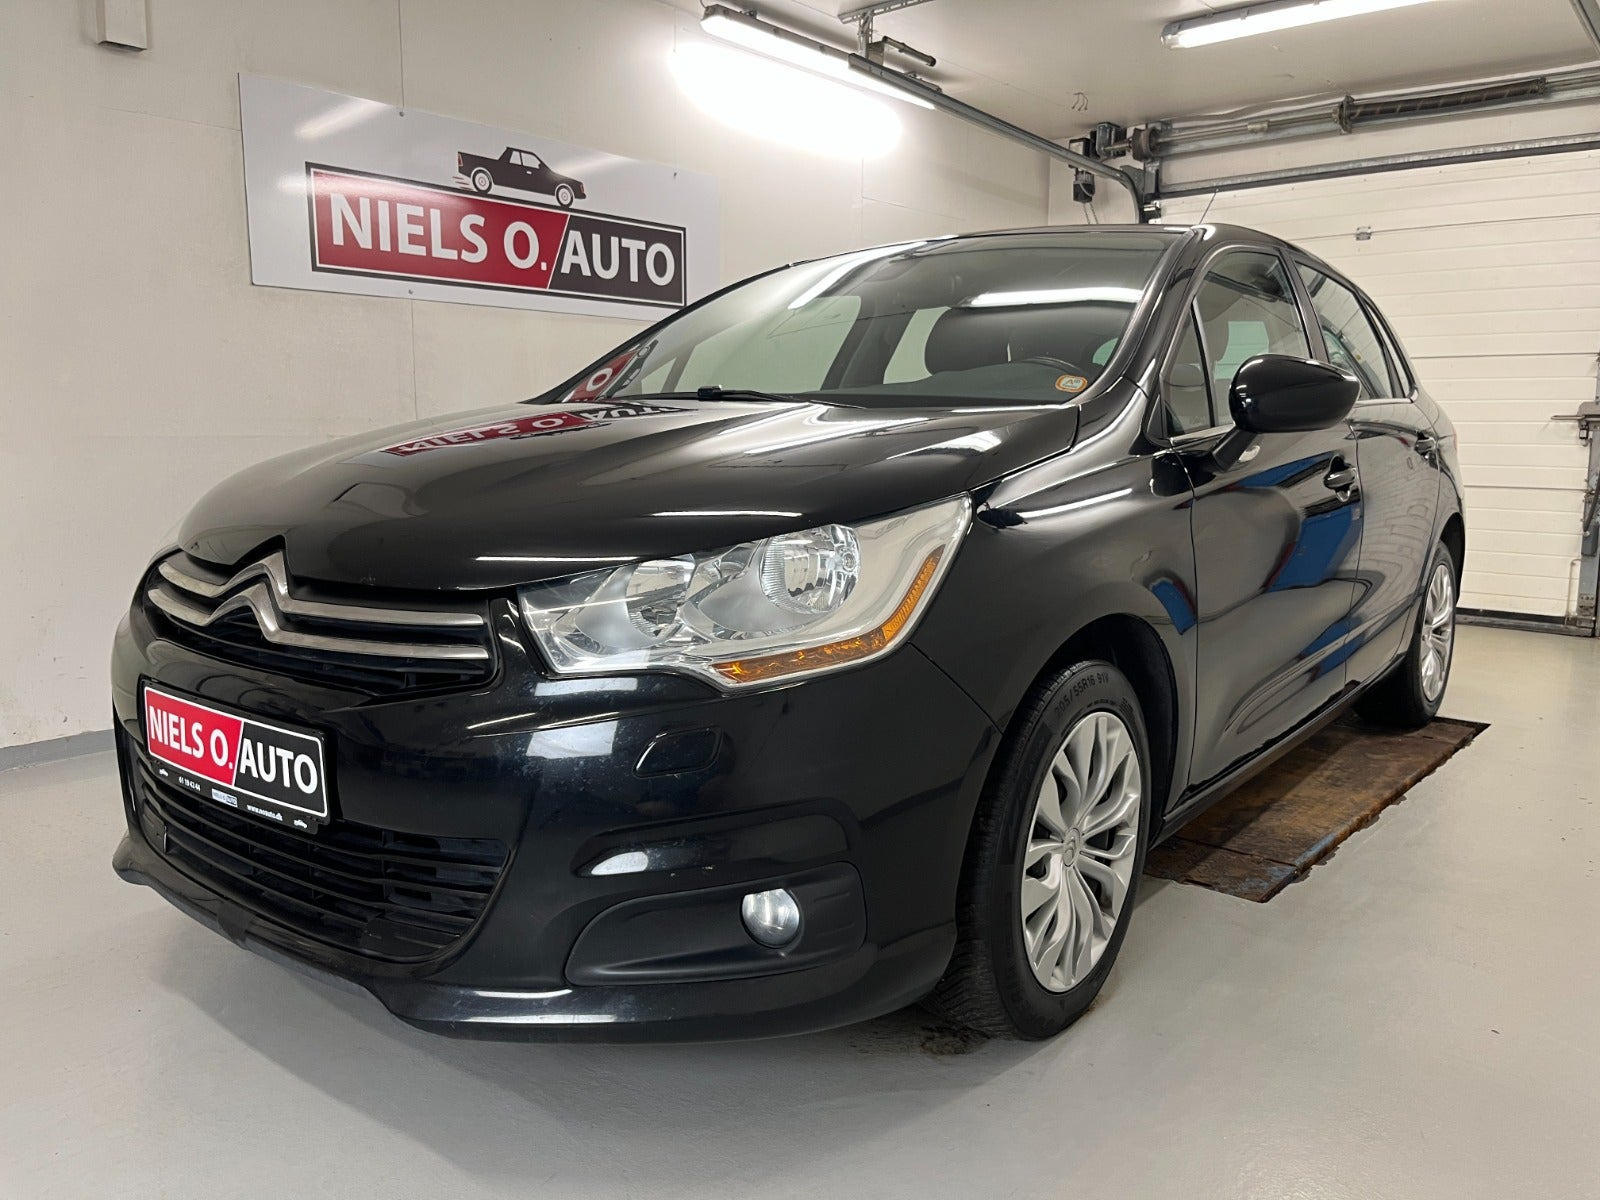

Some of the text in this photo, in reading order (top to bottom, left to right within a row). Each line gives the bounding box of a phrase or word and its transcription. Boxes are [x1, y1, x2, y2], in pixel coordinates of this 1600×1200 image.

[329, 191, 676, 287] NIELS O. AUTO
[149, 705, 318, 794] NIELS O. AUTO
